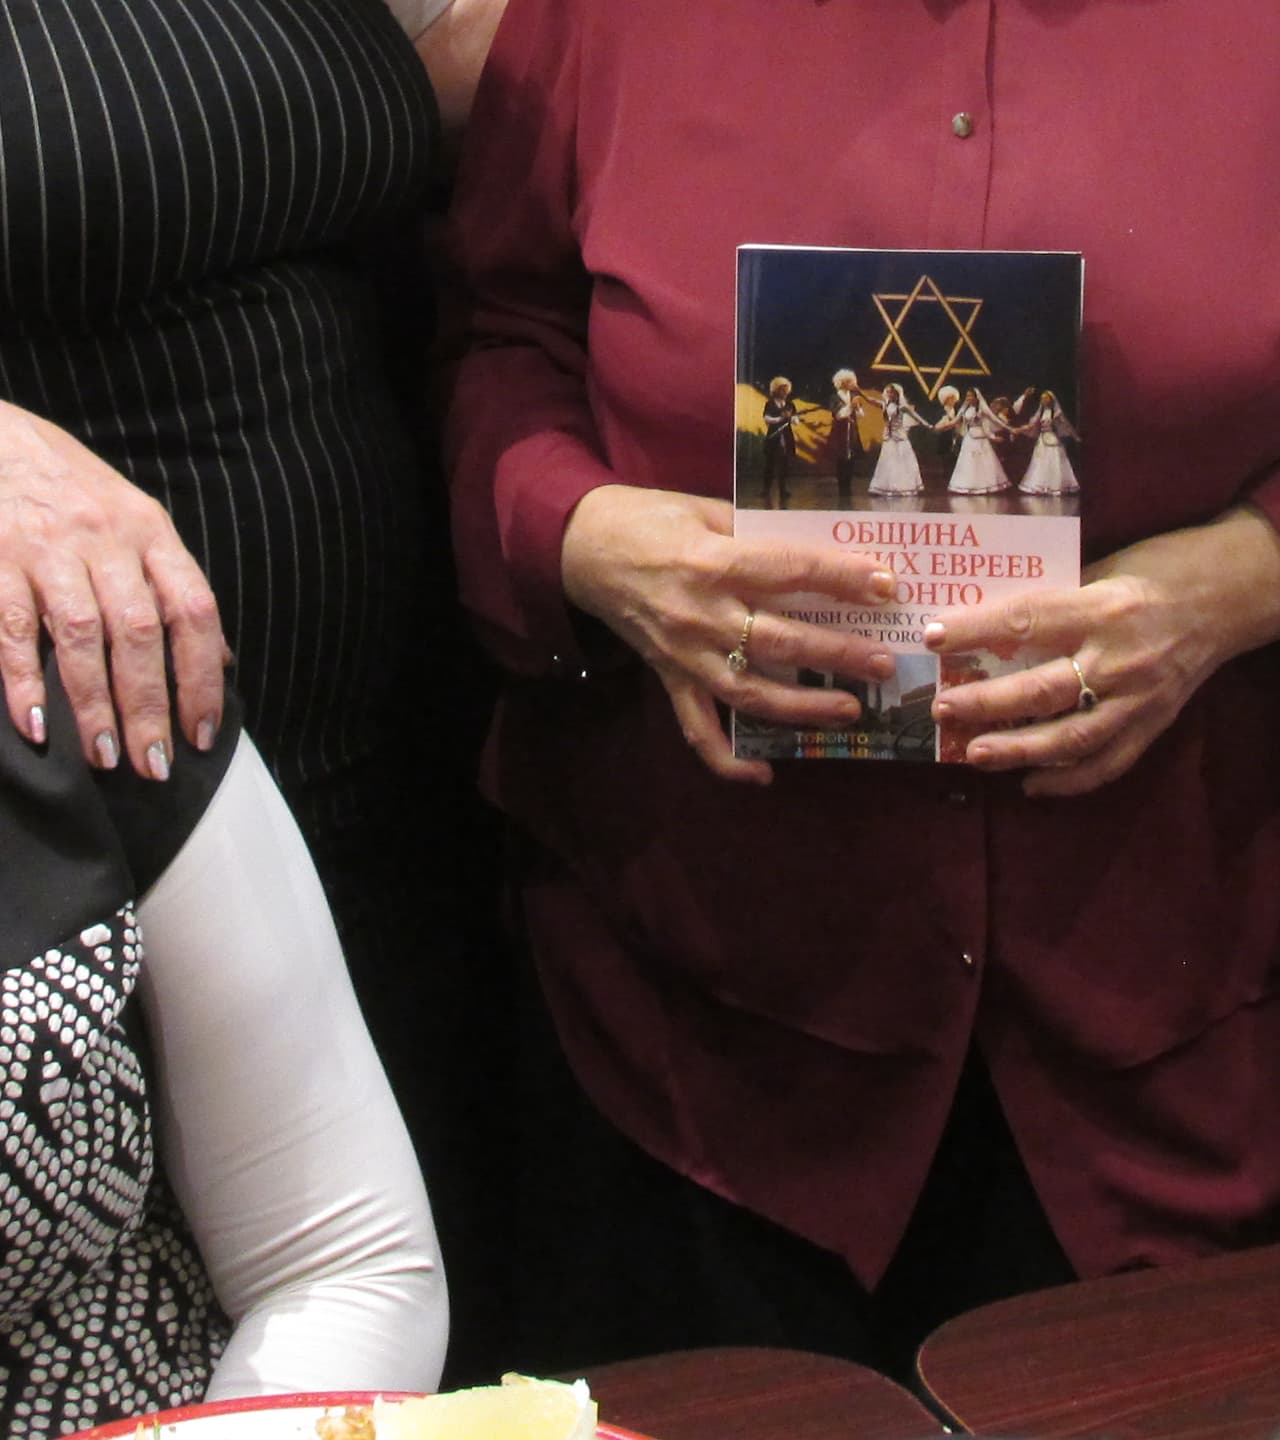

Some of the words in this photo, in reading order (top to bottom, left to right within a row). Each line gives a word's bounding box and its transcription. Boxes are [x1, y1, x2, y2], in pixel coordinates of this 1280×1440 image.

[832, 520, 980, 549] ОБЩИНА
[929, 552, 1046, 579] ЕВРЕЕВ
[895, 581, 984, 607] ОНТО
[846, 611, 915, 626] GORSKY
[877, 630, 924, 644] TORO
